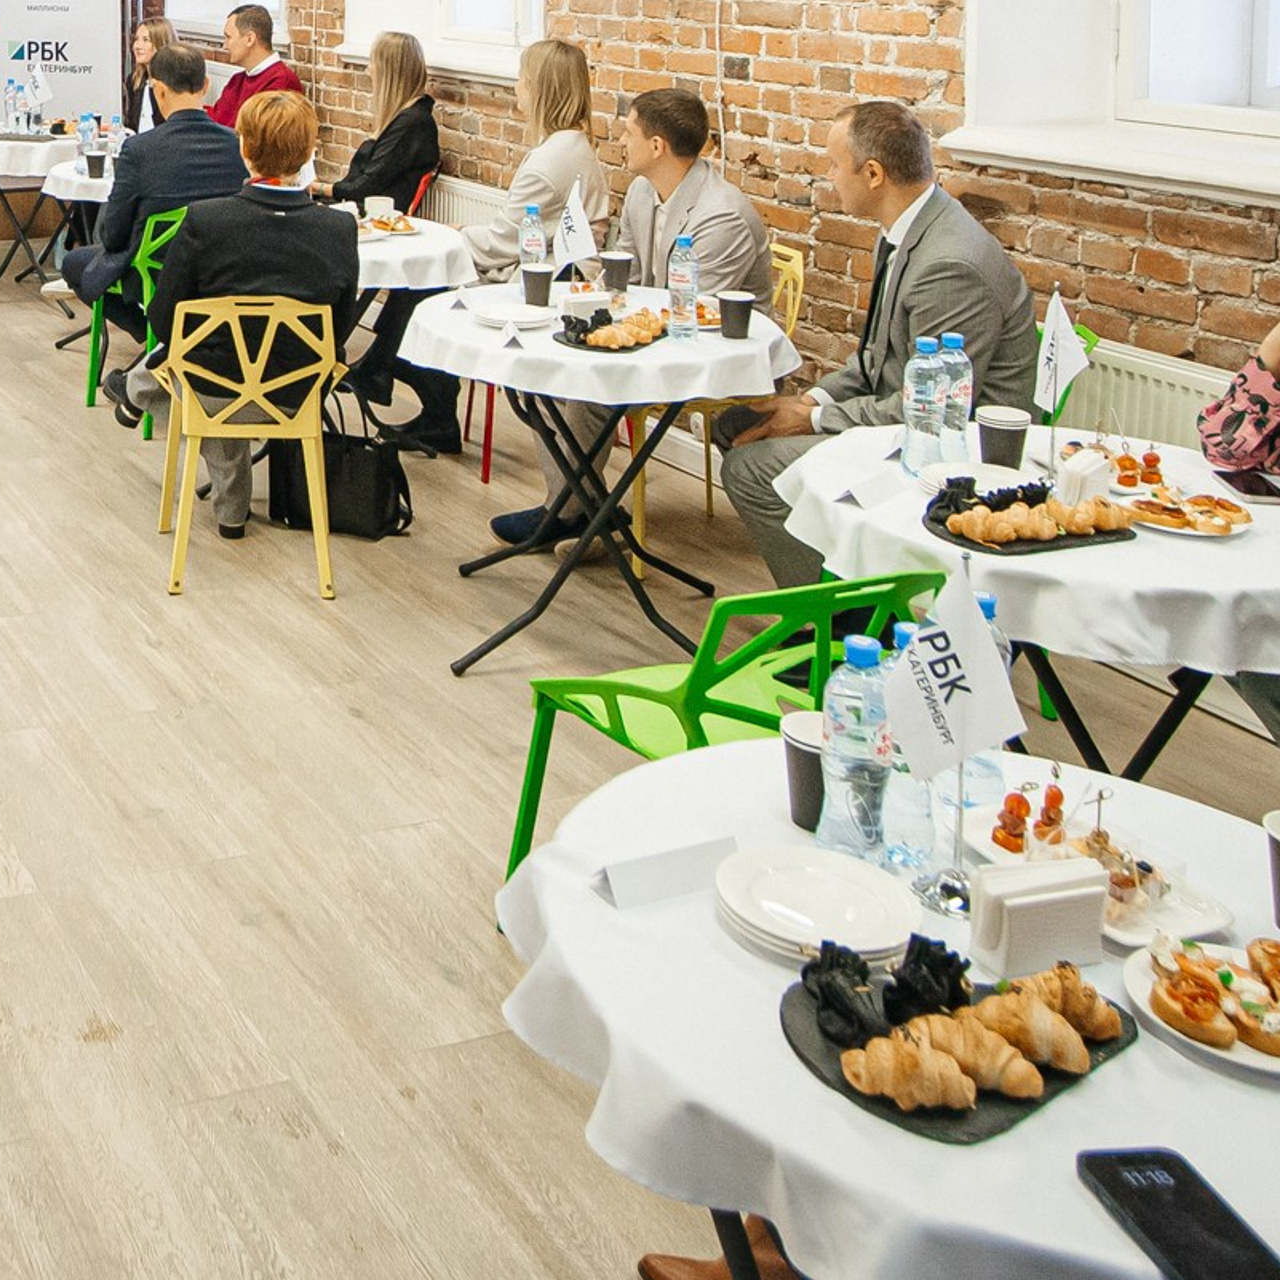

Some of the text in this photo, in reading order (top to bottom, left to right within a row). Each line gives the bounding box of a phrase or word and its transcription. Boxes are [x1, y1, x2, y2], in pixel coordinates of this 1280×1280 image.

[27, 41, 69, 62] РБК
[917, 630, 973, 705] РБК
[907, 642, 956, 746] КАТЕРИНБУРГ
[1122, 1168, 1176, 1187] 11:18
